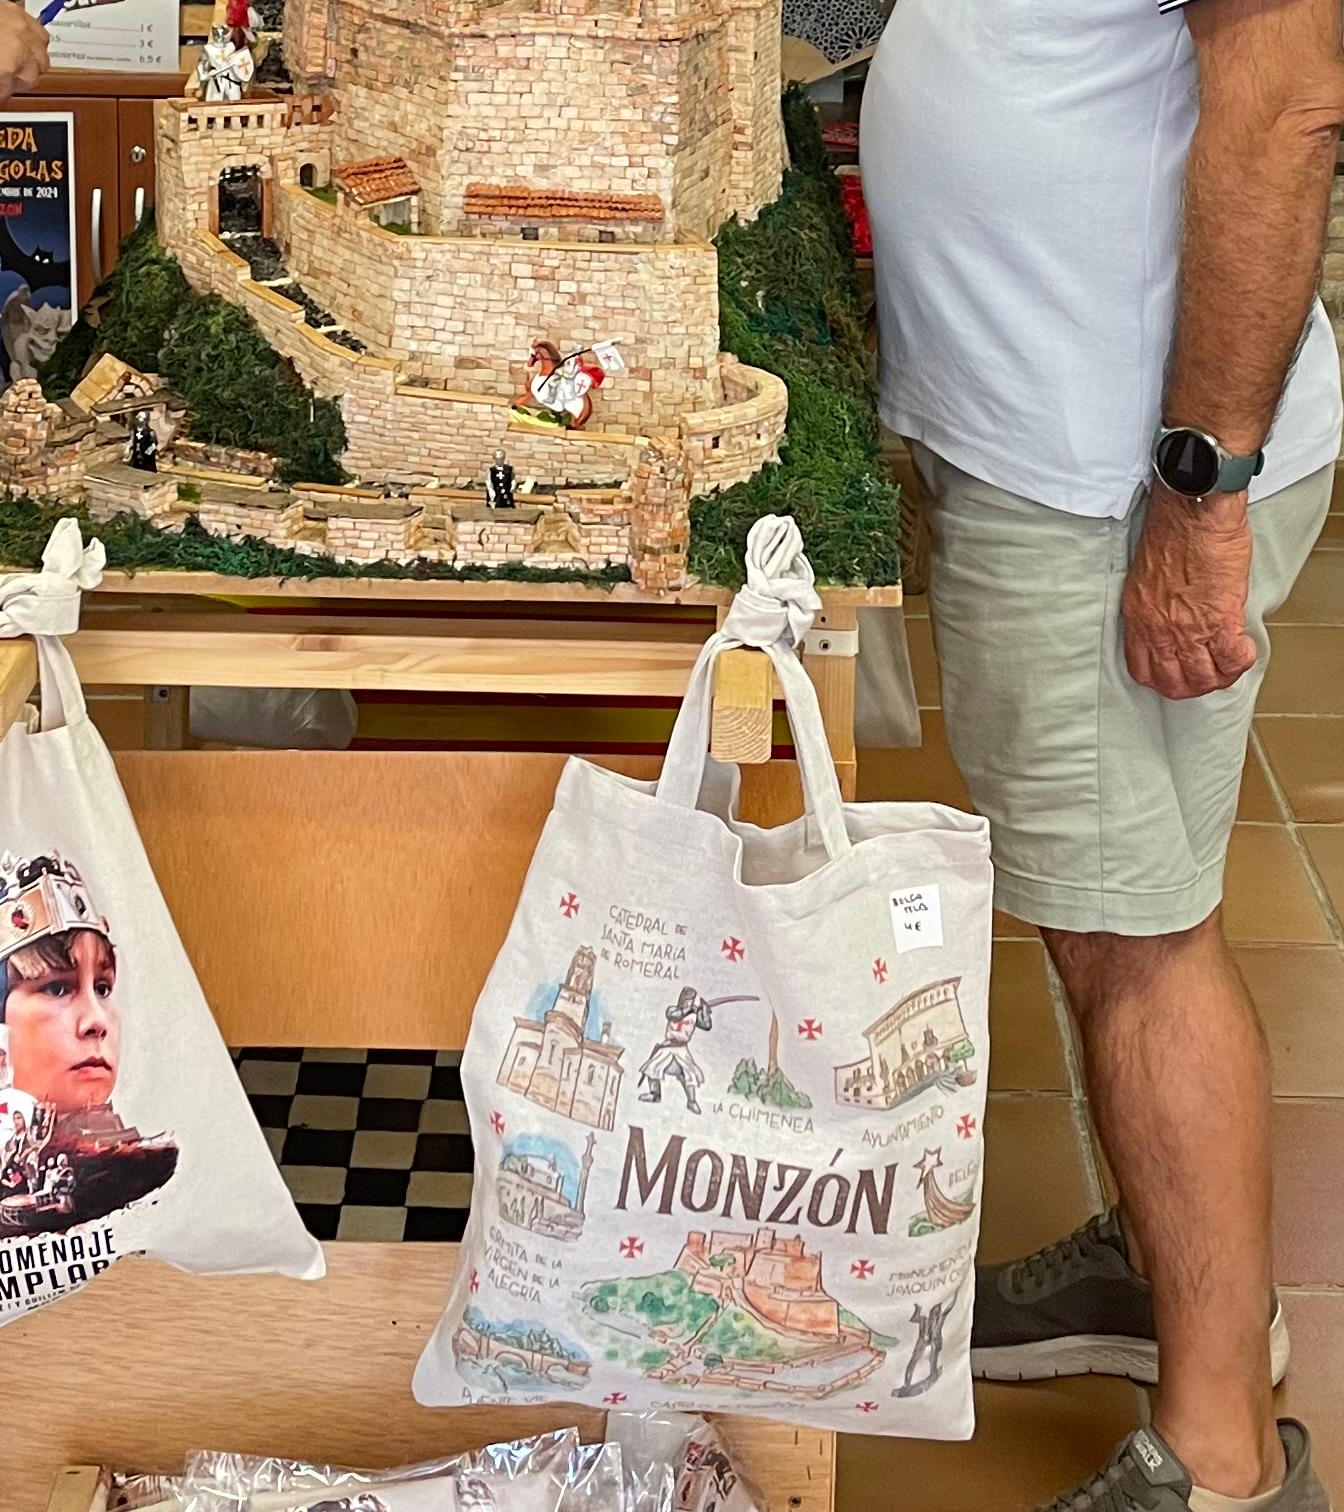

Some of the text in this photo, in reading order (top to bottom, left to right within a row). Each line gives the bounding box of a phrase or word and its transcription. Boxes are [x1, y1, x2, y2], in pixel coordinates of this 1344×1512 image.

[23, 187, 34, 197] DE
[36, 186, 58, 199] 2024
[609, 904, 669, 936] CATEDRAL
[601, 923, 635, 954] SANTA
[614, 952, 680, 981] ROMERAL
[712, 1102, 815, 1135] LA CHIMENEA
[862, 1104, 945, 1149] AYUNTAMIENTO
[615, 1124, 899, 1235] MONZÓN
[484, 1245, 529, 1281] VIRGEN
